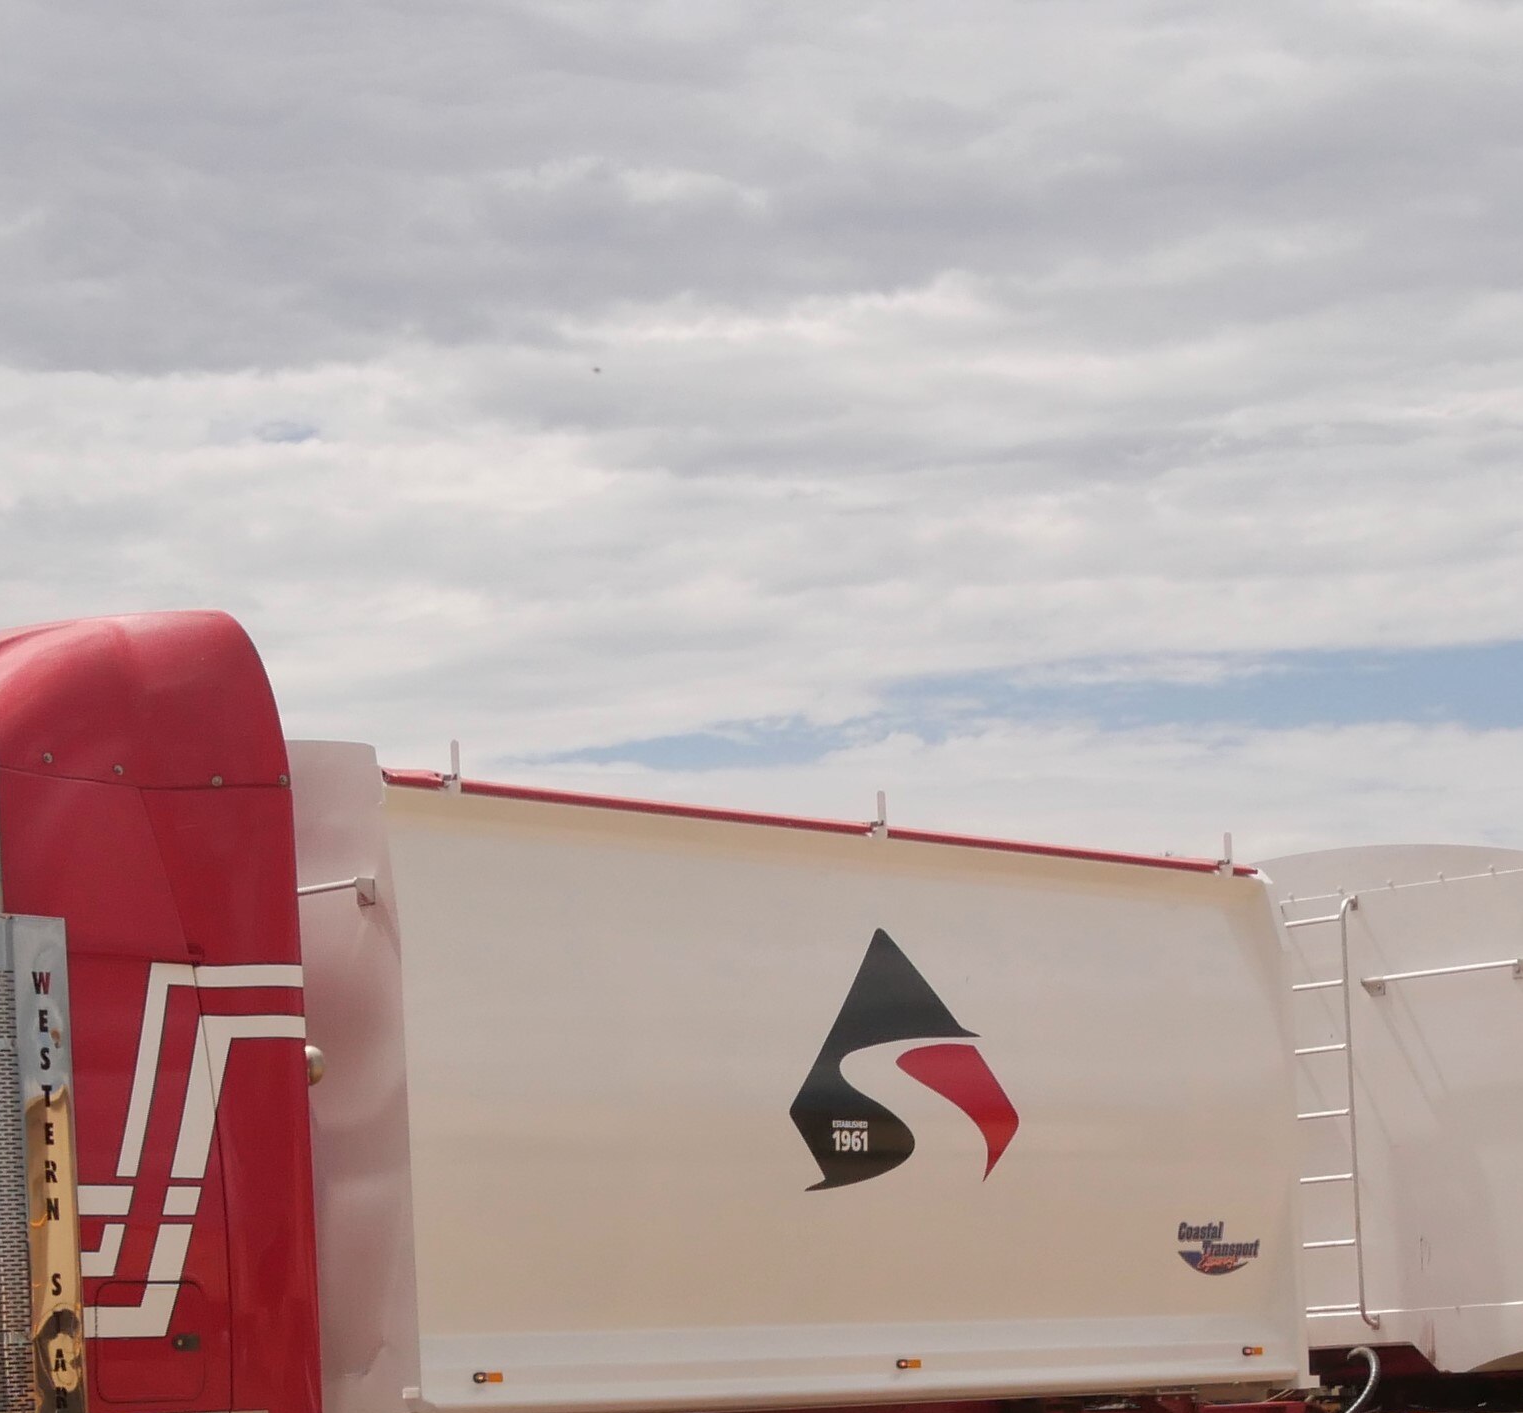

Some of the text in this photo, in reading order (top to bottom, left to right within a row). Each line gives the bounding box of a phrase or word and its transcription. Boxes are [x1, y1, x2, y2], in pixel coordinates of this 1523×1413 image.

[31, 971, 60, 1222] WESTERN
[832, 1130, 868, 1151] 1961
[1178, 1221, 1224, 1241] Coastal
[1202, 1240, 1260, 1257] Transport
